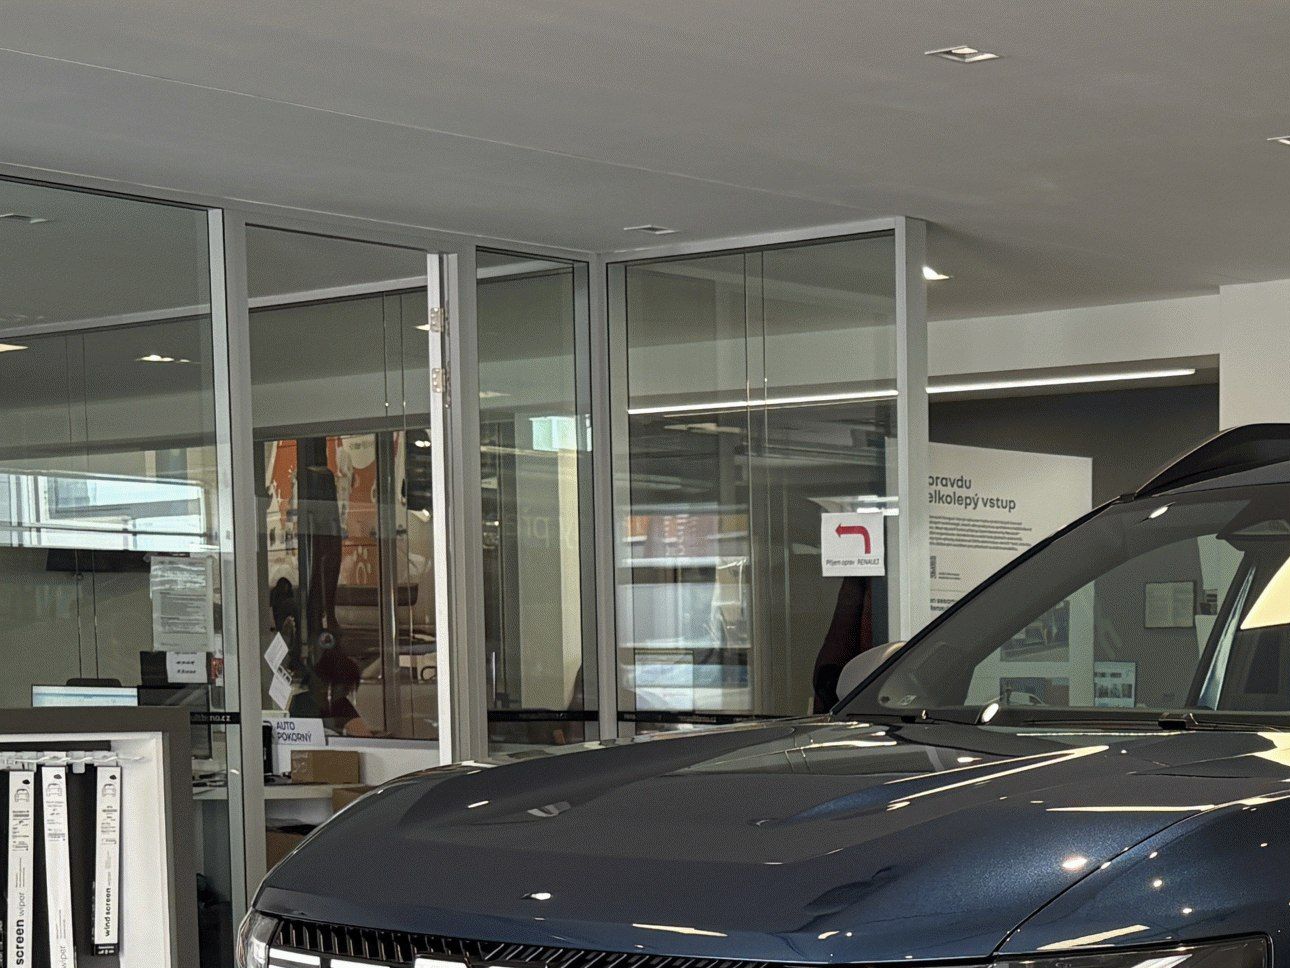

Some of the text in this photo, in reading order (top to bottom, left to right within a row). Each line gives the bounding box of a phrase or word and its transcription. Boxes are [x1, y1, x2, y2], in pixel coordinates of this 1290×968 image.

[928, 475, 972, 489] pravdu
[928, 492, 1016, 512] elkolepý vstup
[276, 721, 296, 731] AUTO
[276, 731, 312, 743] POKORNÝ
[16, 892, 27, 916] wiper
[104, 888, 112, 915] screen
[103, 917, 112, 938] wind
[14, 919, 25, 966] screen
